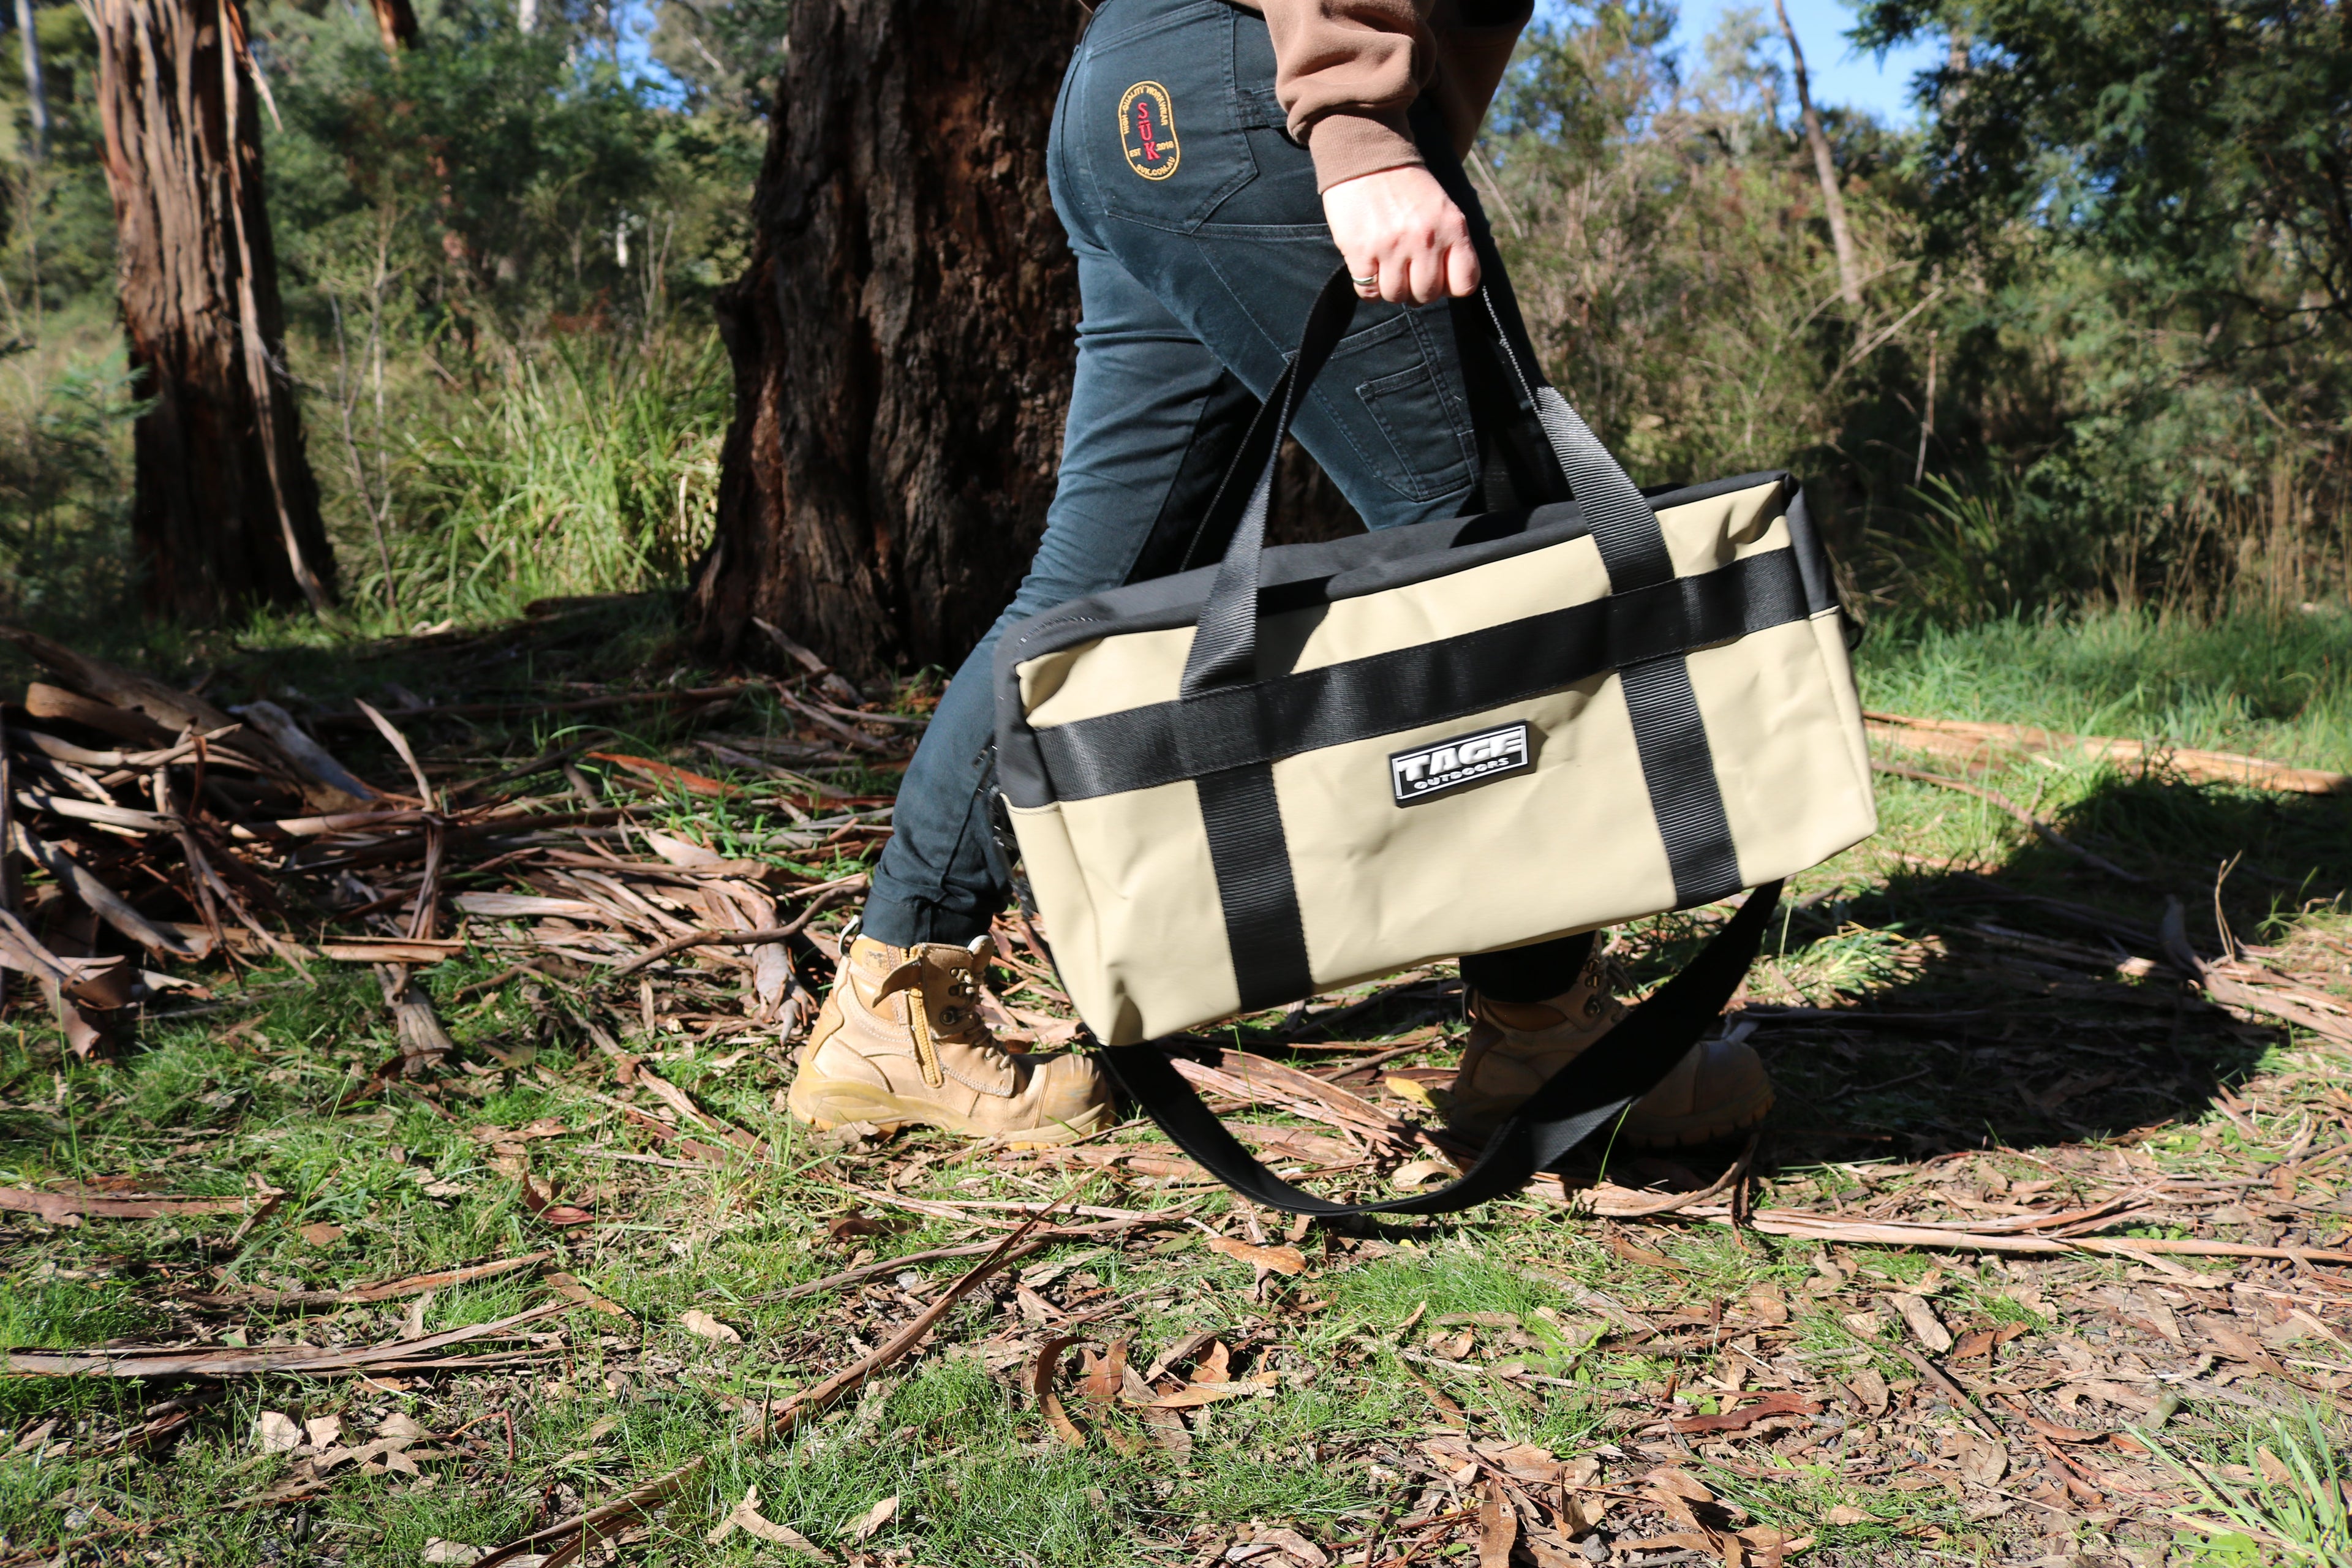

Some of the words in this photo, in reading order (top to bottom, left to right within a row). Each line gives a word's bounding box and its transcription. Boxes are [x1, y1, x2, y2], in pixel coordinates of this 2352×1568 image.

[1146, 85, 1168, 126] WORKWEAR
[1129, 148, 1141, 157] EST
[1156, 140, 1174, 151] 2018
[1414, 757, 1509, 790] OUTDOORS
